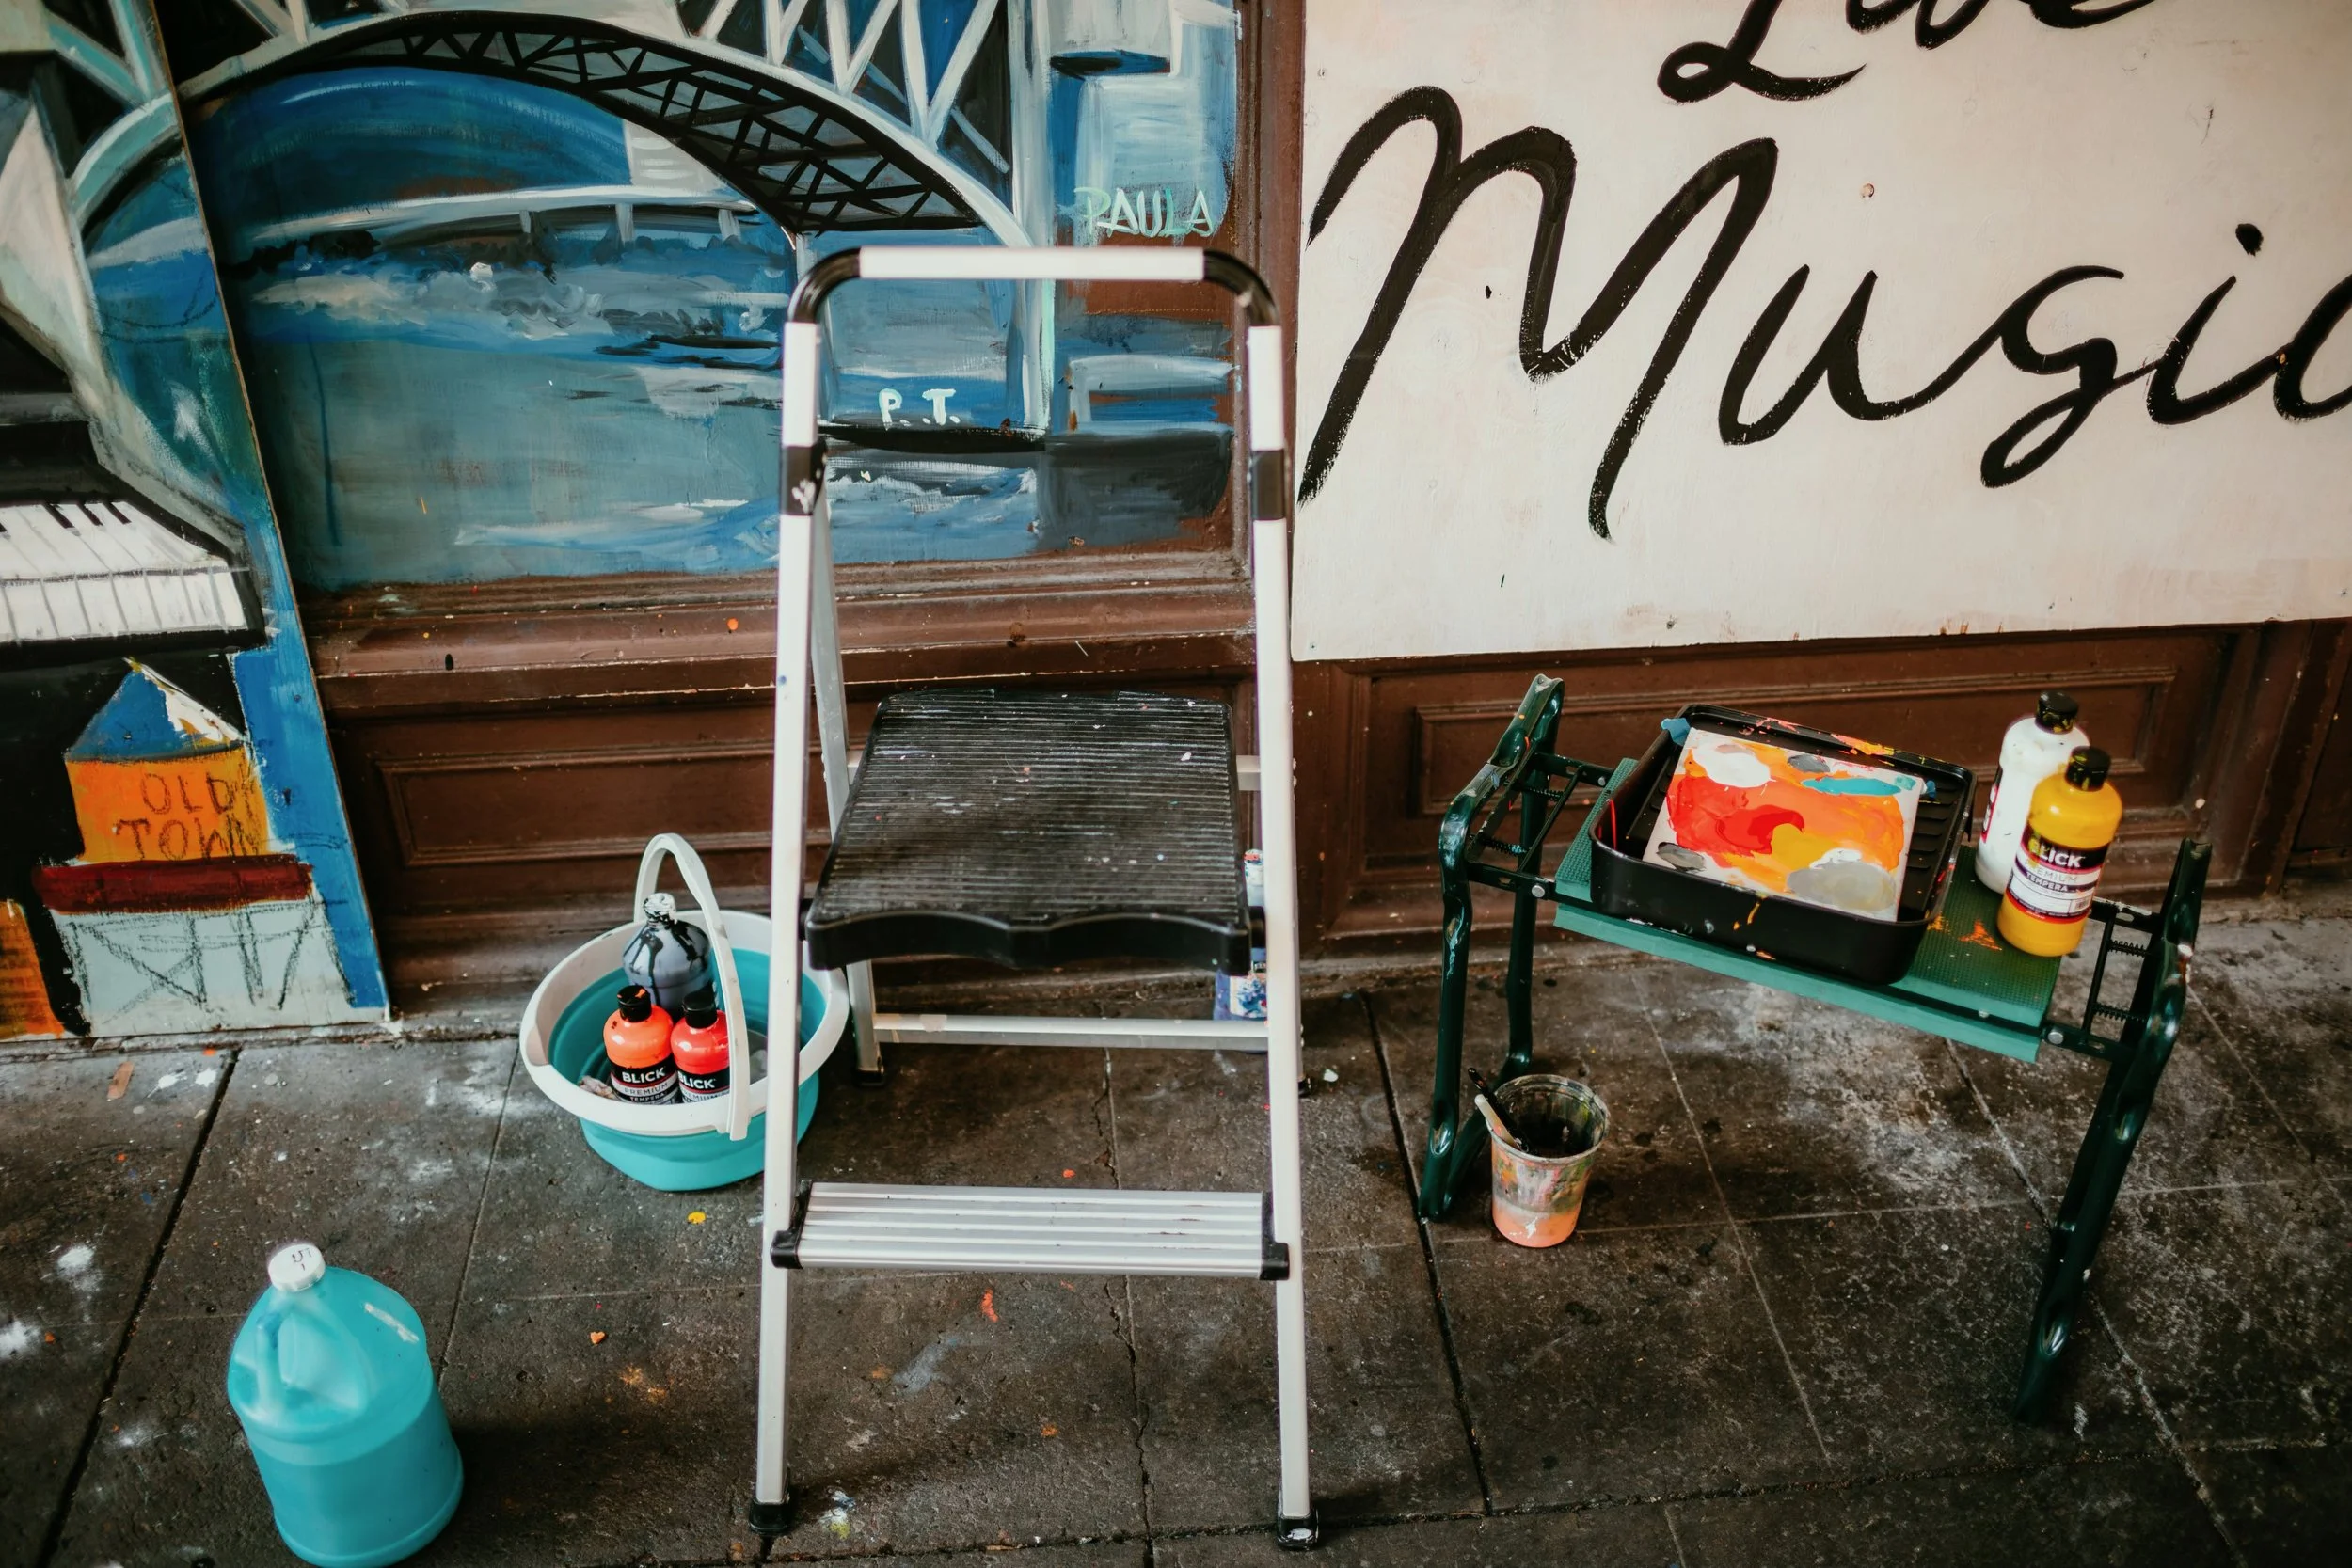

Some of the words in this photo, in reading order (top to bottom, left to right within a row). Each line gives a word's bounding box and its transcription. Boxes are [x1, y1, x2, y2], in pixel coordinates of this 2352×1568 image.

[1073, 186, 1214, 238] PAULA
[141, 771, 234, 816] OLD
[114, 813, 261, 863] TOWN
[2026, 871, 2069, 893] TEMPERA
[622, 1068, 666, 1083] BLICK
[677, 1070, 715, 1089] BLICK
[624, 1083, 668, 1096] PREMIUM
